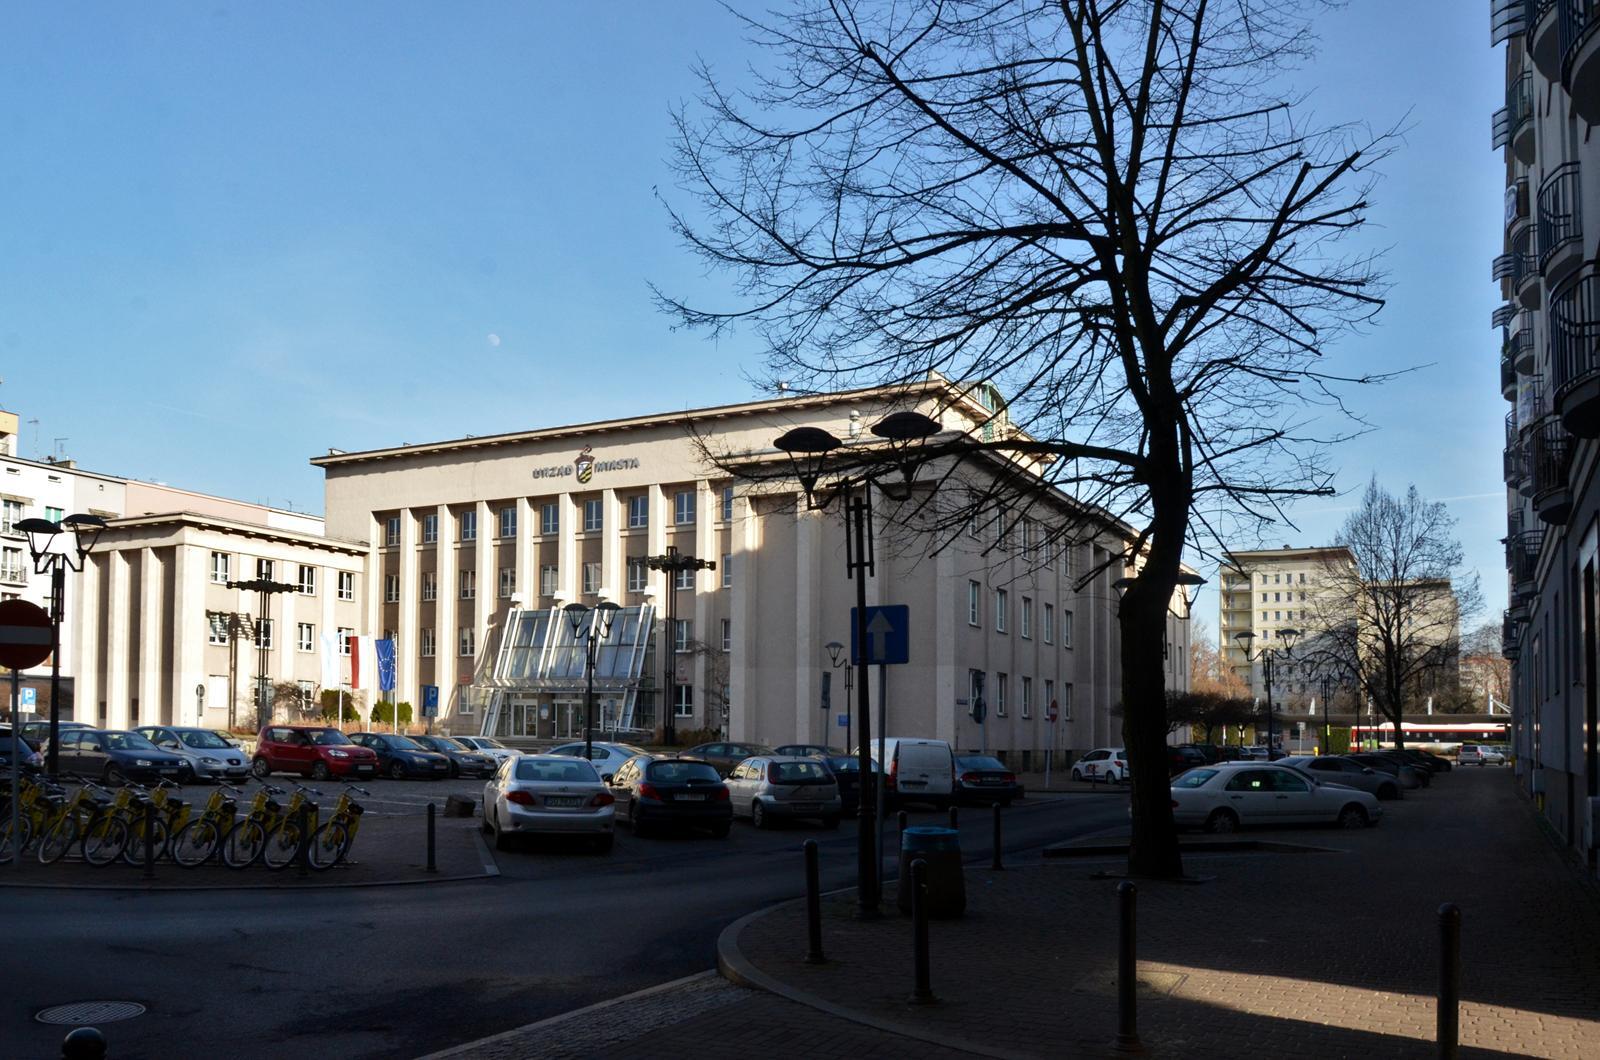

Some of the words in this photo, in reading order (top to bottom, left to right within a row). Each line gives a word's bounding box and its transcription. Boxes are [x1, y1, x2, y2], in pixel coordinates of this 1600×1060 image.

[594, 457, 640, 474] MIASTA
[25, 689, 33, 699] P
[429, 688, 437, 700] P
